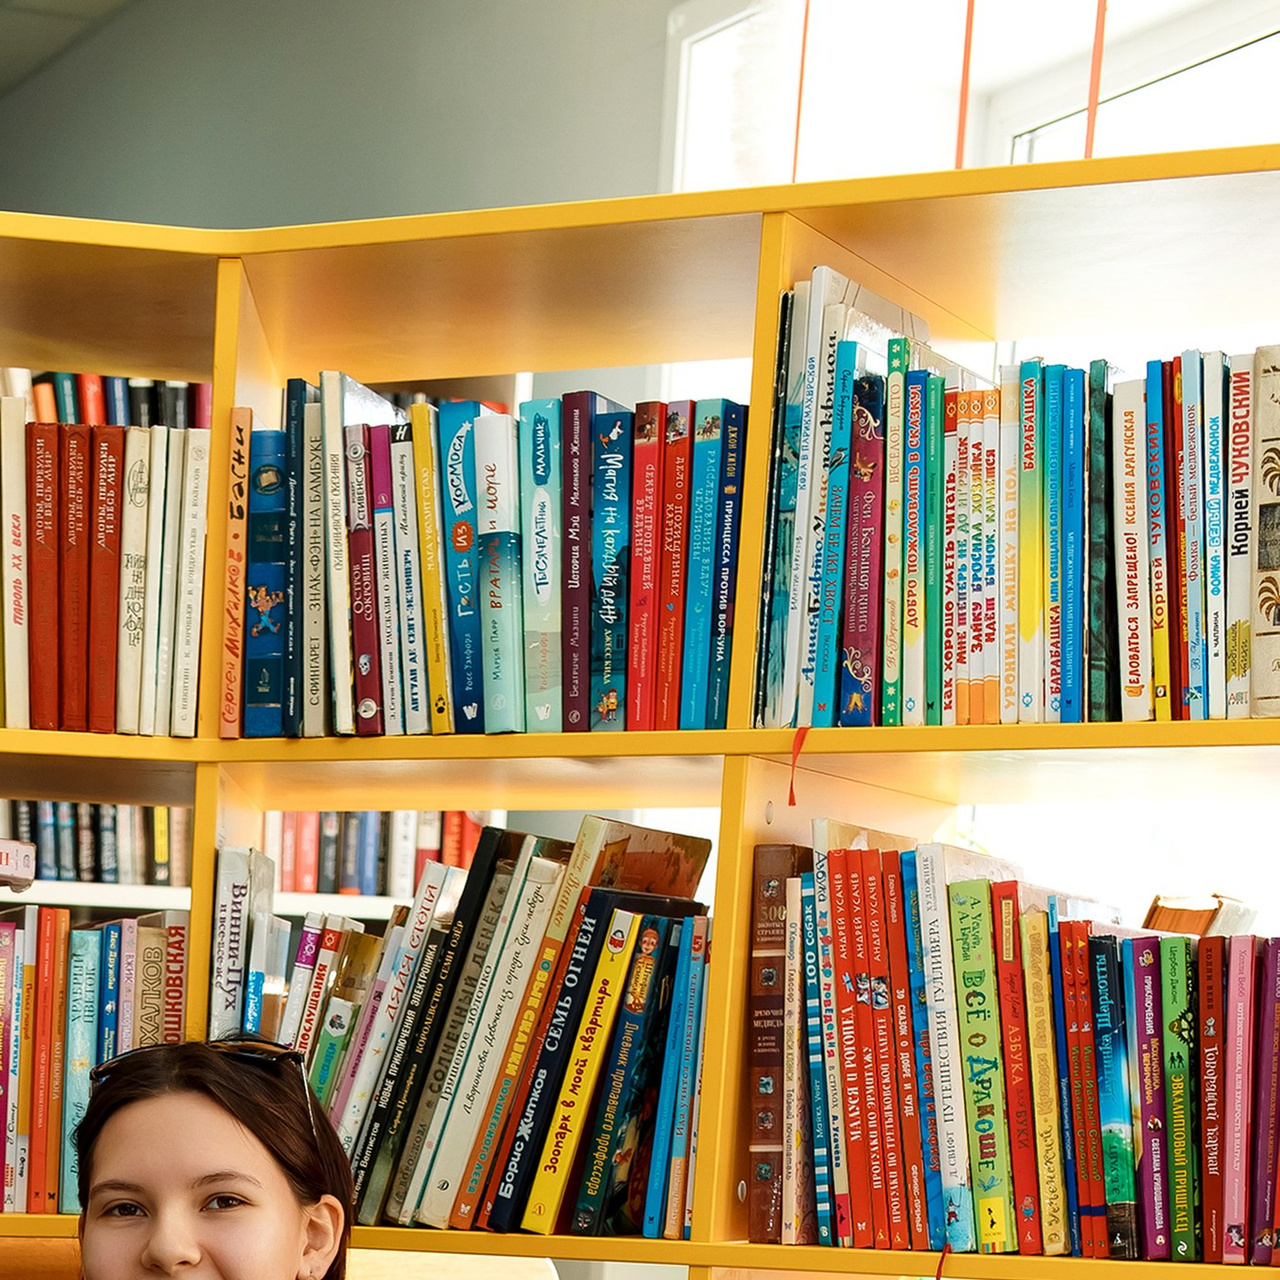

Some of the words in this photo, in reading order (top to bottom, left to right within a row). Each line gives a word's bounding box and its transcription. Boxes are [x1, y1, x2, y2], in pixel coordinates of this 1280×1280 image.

[535, 422, 546, 475] МАЛЬЧИК
[1023, 378, 1035, 470] БАРАБАШКА
[1231, 371, 1250, 484] ЧУКОВСКИЙ
[98, 442, 108, 500] ПЕРЕУЛКИ
[107, 454, 116, 483] МИР
[310, 436, 321, 503] БАМБУКЕ
[356, 463, 365, 520] СТИВЕНСОН
[11, 514, 22, 546] ВЕКА
[106, 491, 115, 520] ВЕСЬ
[722, 501, 733, 564] ПРИНЦЕССА
[906, 464, 919, 573] ПОЖАЛОВАТЬ
[1232, 489, 1250, 555] Корней
[13, 578, 23, 625] ПАРОЛЬ
[353, 564, 362, 613] ОСТРОВ
[361, 553, 372, 620] СОКРОВИЩ
[720, 567, 729, 610] ПРОТИВ
[906, 579, 918, 627] ДОБРО
[716, 614, 727, 662] ВОРЧУНА
[1126, 617, 1143, 697] ЦЕЛОВАТЬСЯ
[164, 926, 185, 1044] ОШКОВСКАЯ
[928, 919, 945, 1002] ГУЛЛИВЕРА
[378, 1079, 394, 1108] НОВЫЕ
[386, 1010, 416, 1076] ПРИКЛЮЧЕНИЯ
[410, 944, 437, 1007] ЭЛЕКТРОНИКА
[498, 1142, 524, 1198] Борис
[516, 1069, 547, 1142] Житков
[545, 996, 572, 1051] СЕМЬ
[564, 916, 596, 988] ОГНЕЙ
[544, 1114, 571, 1174] Зоопарк
[578, 978, 611, 1051] квартире
[936, 1009, 954, 1122] ПУТЕШЕСТВИЯ
